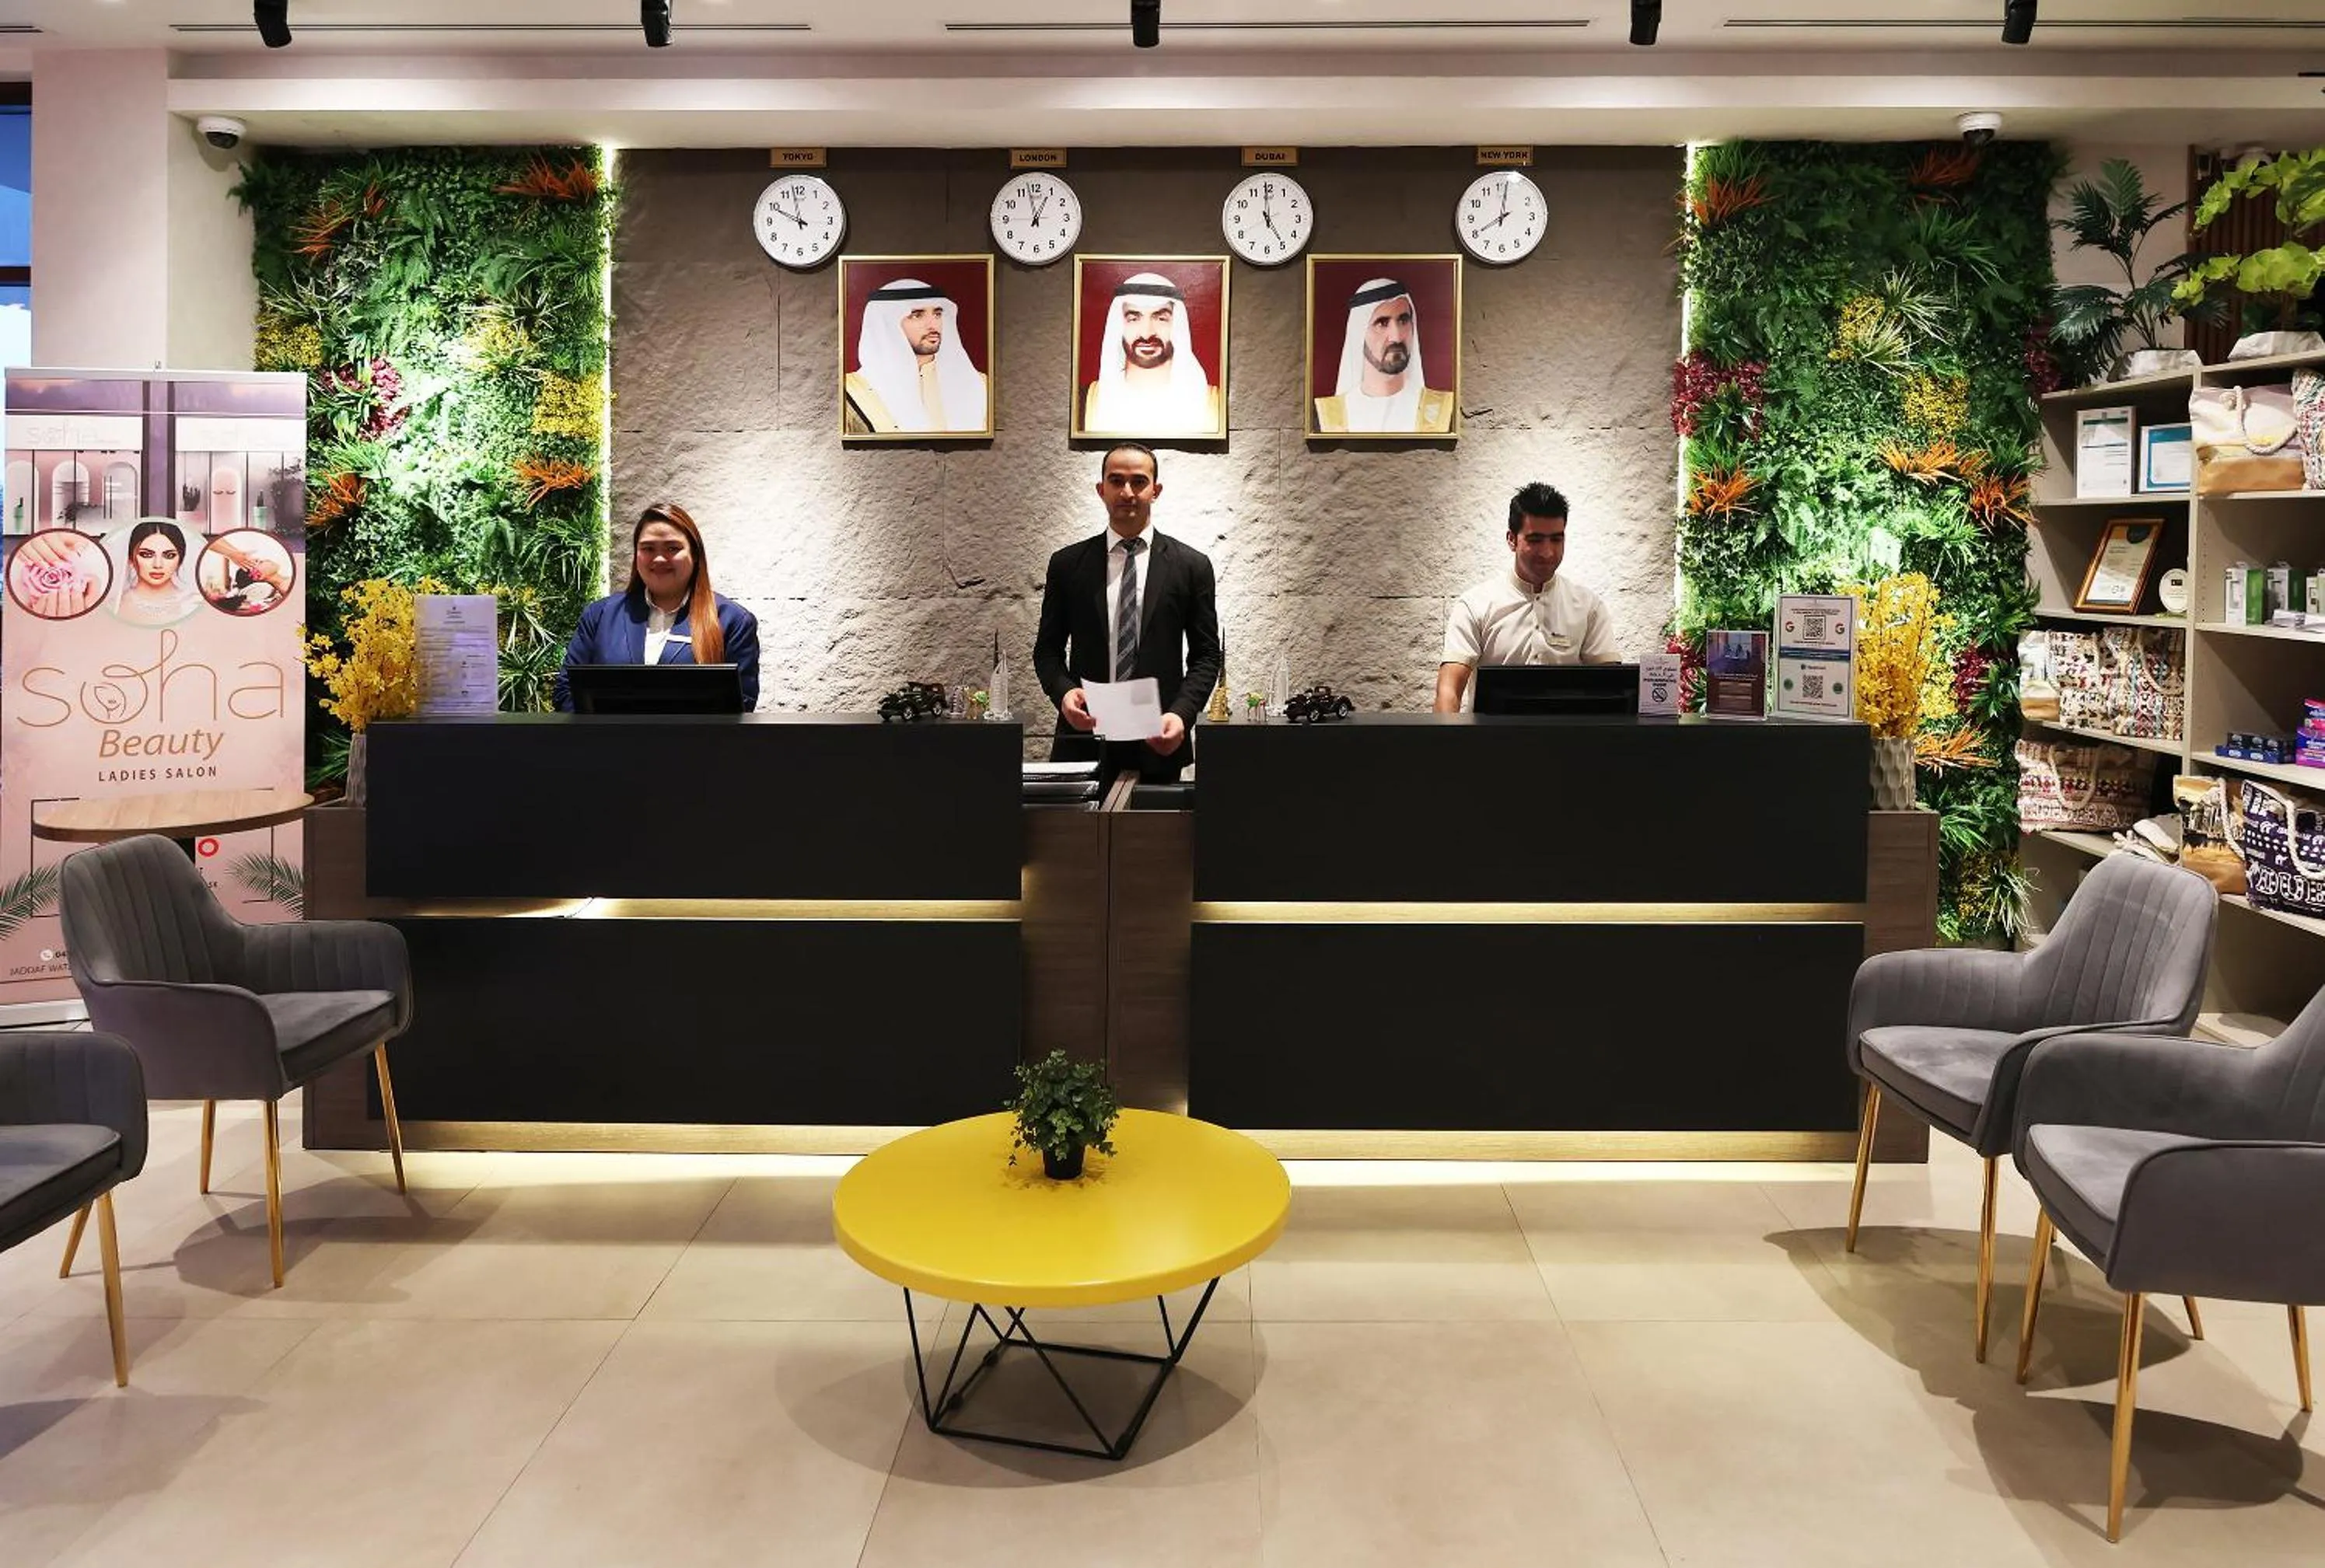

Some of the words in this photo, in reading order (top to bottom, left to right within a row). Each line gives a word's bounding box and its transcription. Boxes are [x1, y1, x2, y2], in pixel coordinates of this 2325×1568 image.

[782, 152, 813, 161] TOKYO
[1019, 154, 1057, 162] LONDON
[1254, 152, 1285, 161] DUBAI
[1480, 151, 1499, 159] NEW
[1504, 151, 1529, 159] YORK
[795, 186, 805, 195] 12
[1016, 188, 1026, 197] 11
[1030, 183, 1041, 193] 12
[1249, 188, 1258, 197] 11
[1481, 187, 1491, 197] 11
[781, 190, 790, 199] 11
[769, 202, 780, 211] 10
[822, 201, 829, 210] 2
[1005, 200, 1016, 209] 10
[1059, 197, 1065, 207] 2
[1236, 199, 1248, 209] 10
[1290, 199, 1298, 208] 2
[1470, 199, 1481, 208] 10
[827, 216, 834, 225] 3
[1002, 215, 1009, 224] 9
[1063, 213, 1071, 222] 3
[1233, 215, 1241, 224] 9
[1295, 214, 1301, 224] 3
[1467, 214, 1475, 224] 9
[1528, 211, 1536, 222] 3
[767, 217, 773, 226] 9
[823, 232, 830, 240] 4
[1007, 230, 1013, 239] 8
[1060, 229, 1066, 238] 4
[1237, 230, 1244, 239] 8
[1290, 229, 1297, 239] 4
[1471, 229, 1479, 239] 8
[1524, 227, 1531, 236] 4
[770, 232, 778, 242] 8
[781, 243, 788, 252] 7
[812, 243, 819, 252] 5
[1017, 240, 1025, 250] 7
[1048, 239, 1055, 249] 5
[1249, 241, 1256, 250] 7
[1279, 241, 1286, 250] 5
[1483, 239, 1491, 250] 7
[1513, 238, 1520, 249] 5
[796, 247, 803, 256] 6
[1033, 244, 1040, 253] 6
[1264, 244, 1271, 254] 6
[1498, 244, 1505, 253] 6
[16, 629, 285, 728] soha
[99, 728, 225, 761] Beauty
[98, 769, 156, 782] LADIES
[165, 766, 218, 779] SALON
